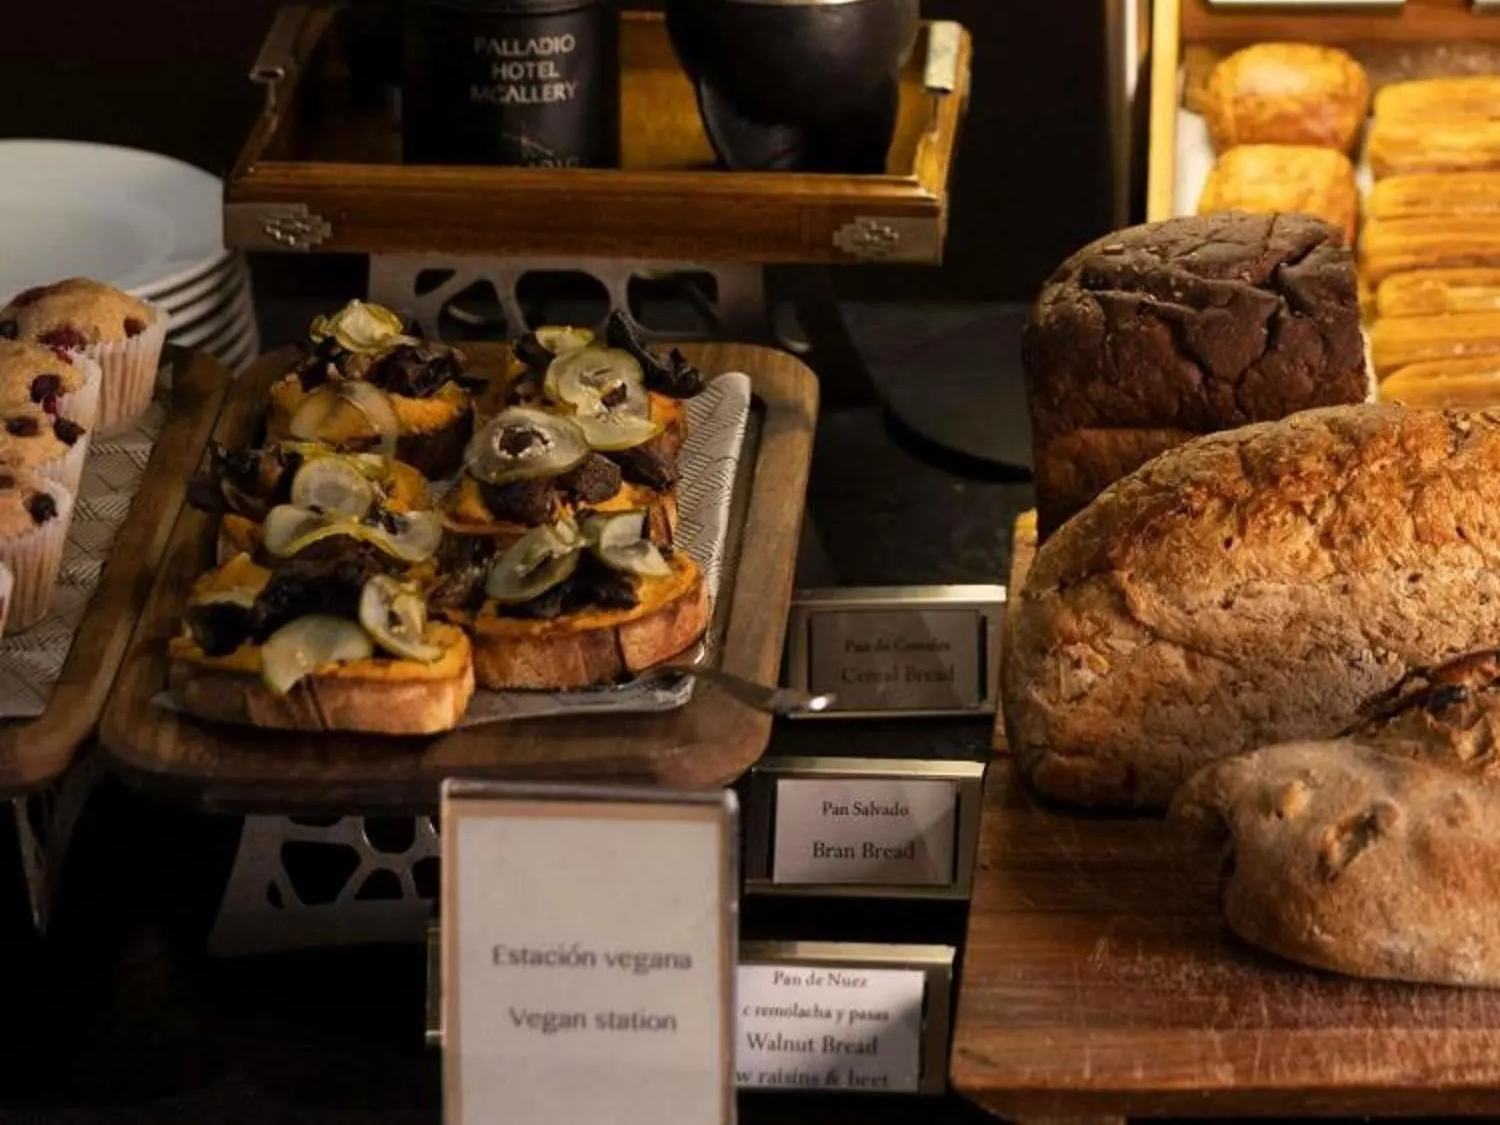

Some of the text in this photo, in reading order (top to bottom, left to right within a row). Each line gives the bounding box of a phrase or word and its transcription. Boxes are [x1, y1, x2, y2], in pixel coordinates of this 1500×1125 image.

[473, 32, 576, 57] PALLADIO
[490, 59, 561, 81] HOTEL
[905, 664, 955, 683] Bread
[822, 800, 909, 817] Pan Salvado
[812, 839, 916, 860] Bran Bread
[491, 941, 693, 976] Estación vegana
[772, 970, 869, 988] Pan de Nuez
[507, 1006, 678, 1035] Vegan station
[755, 1002, 832, 1019] remolacha
[849, 1009, 890, 1025] pasas
[745, 1032, 879, 1055] Walnut Bread
[758, 1067, 819, 1085] raisins
[824, 1068, 841, 1087] &
[848, 1067, 889, 1088] beet
